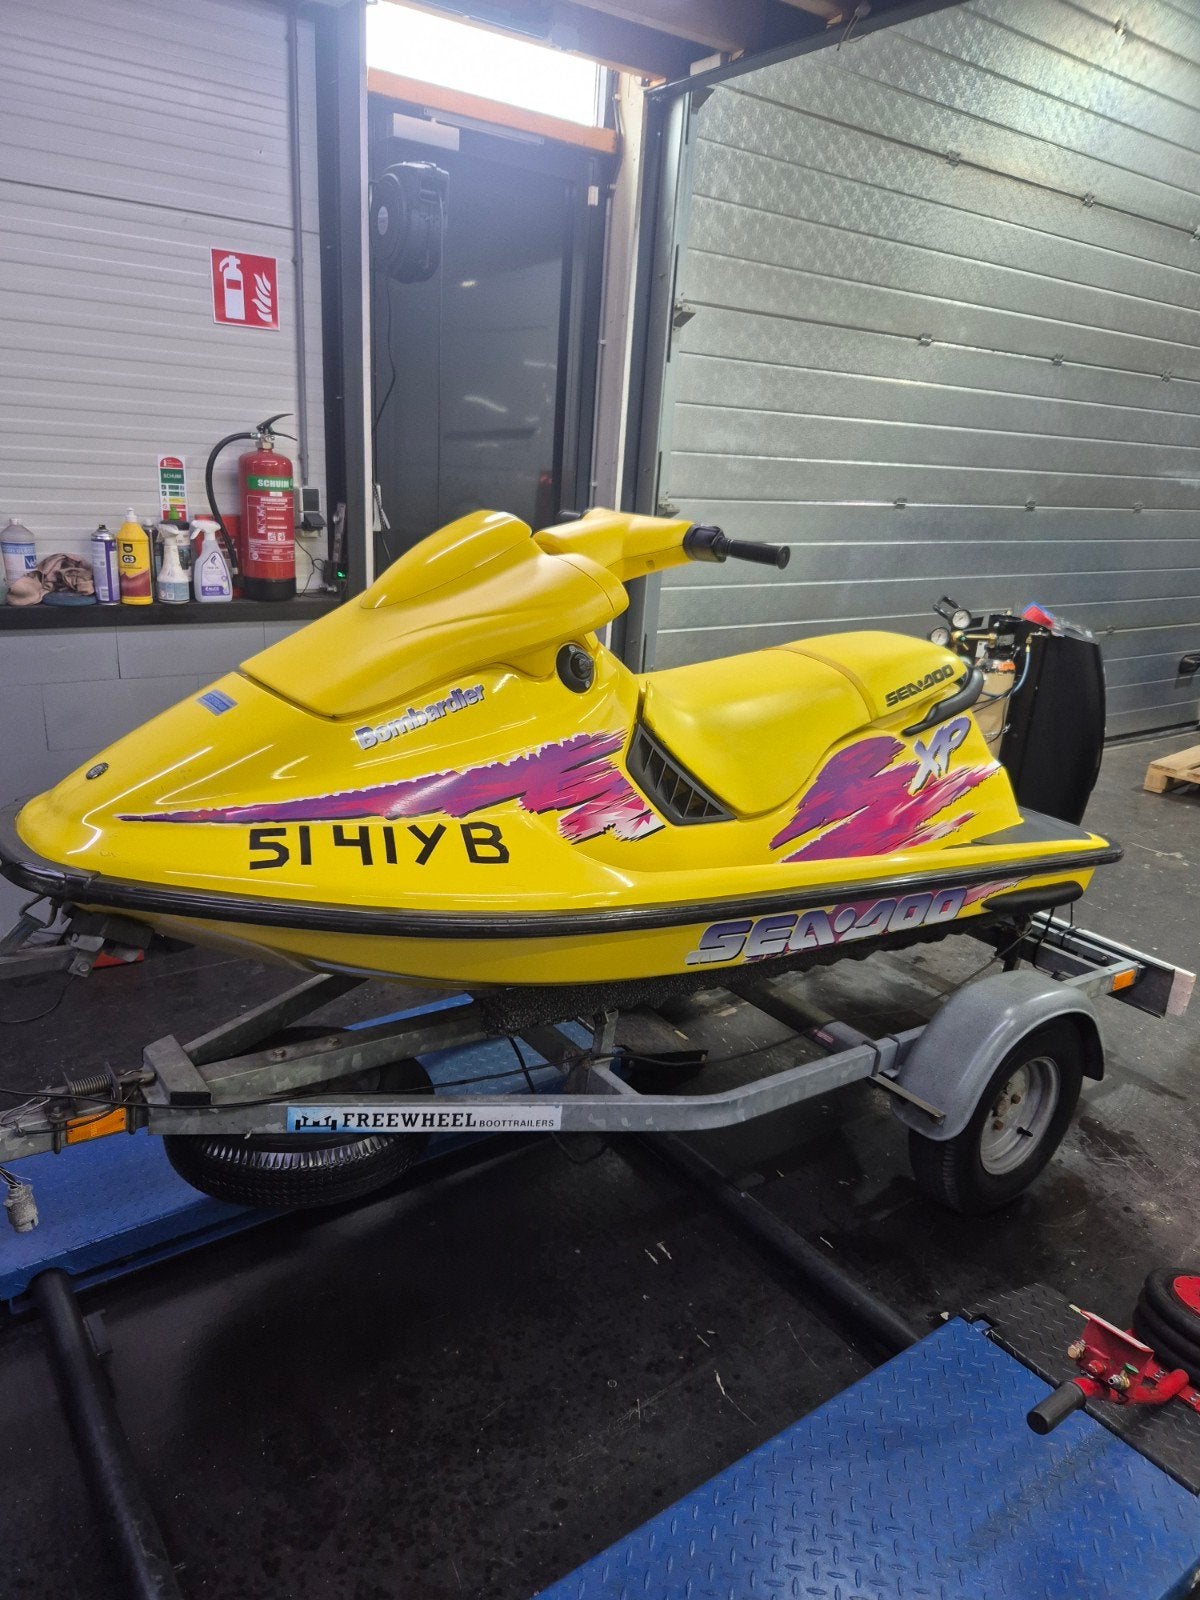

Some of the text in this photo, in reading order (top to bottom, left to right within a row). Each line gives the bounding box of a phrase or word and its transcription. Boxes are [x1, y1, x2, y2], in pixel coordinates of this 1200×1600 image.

[257, 478, 290, 489] SCHUIM
[354, 684, 485, 750] Bombardier
[907, 715, 972, 796] XP
[342, 1112, 554, 1128] FREEWHEEL BOOTTRAILERS
